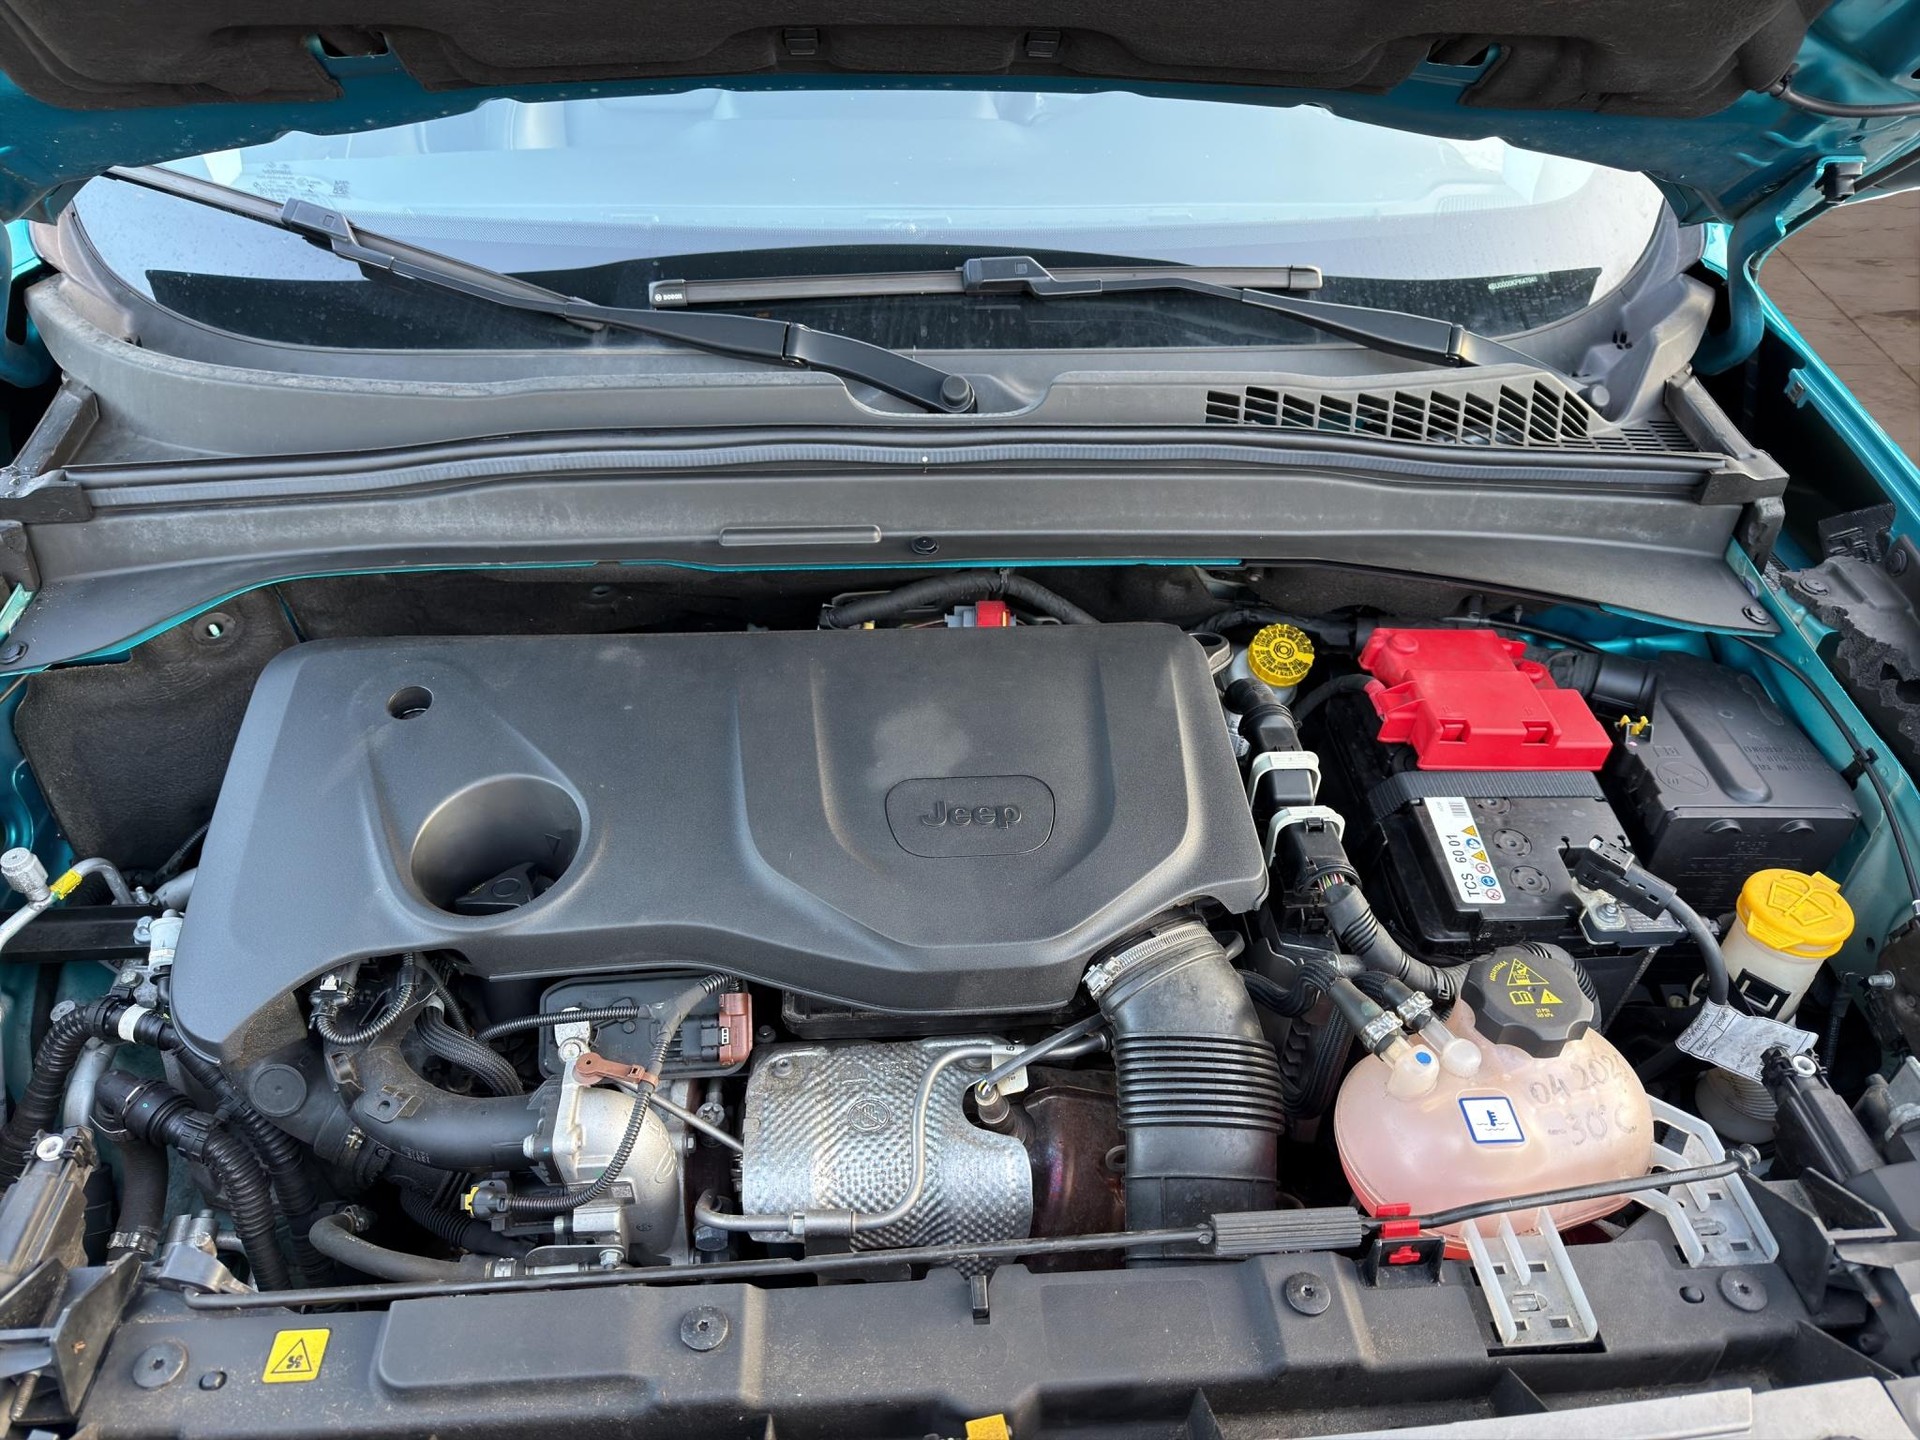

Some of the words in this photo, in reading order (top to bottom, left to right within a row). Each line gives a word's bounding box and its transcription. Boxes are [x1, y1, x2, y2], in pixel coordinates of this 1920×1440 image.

[921, 800, 1022, 830] Jeep
[1461, 873, 1481, 898] TCS
[1530, 1073, 1571, 1104] 04
